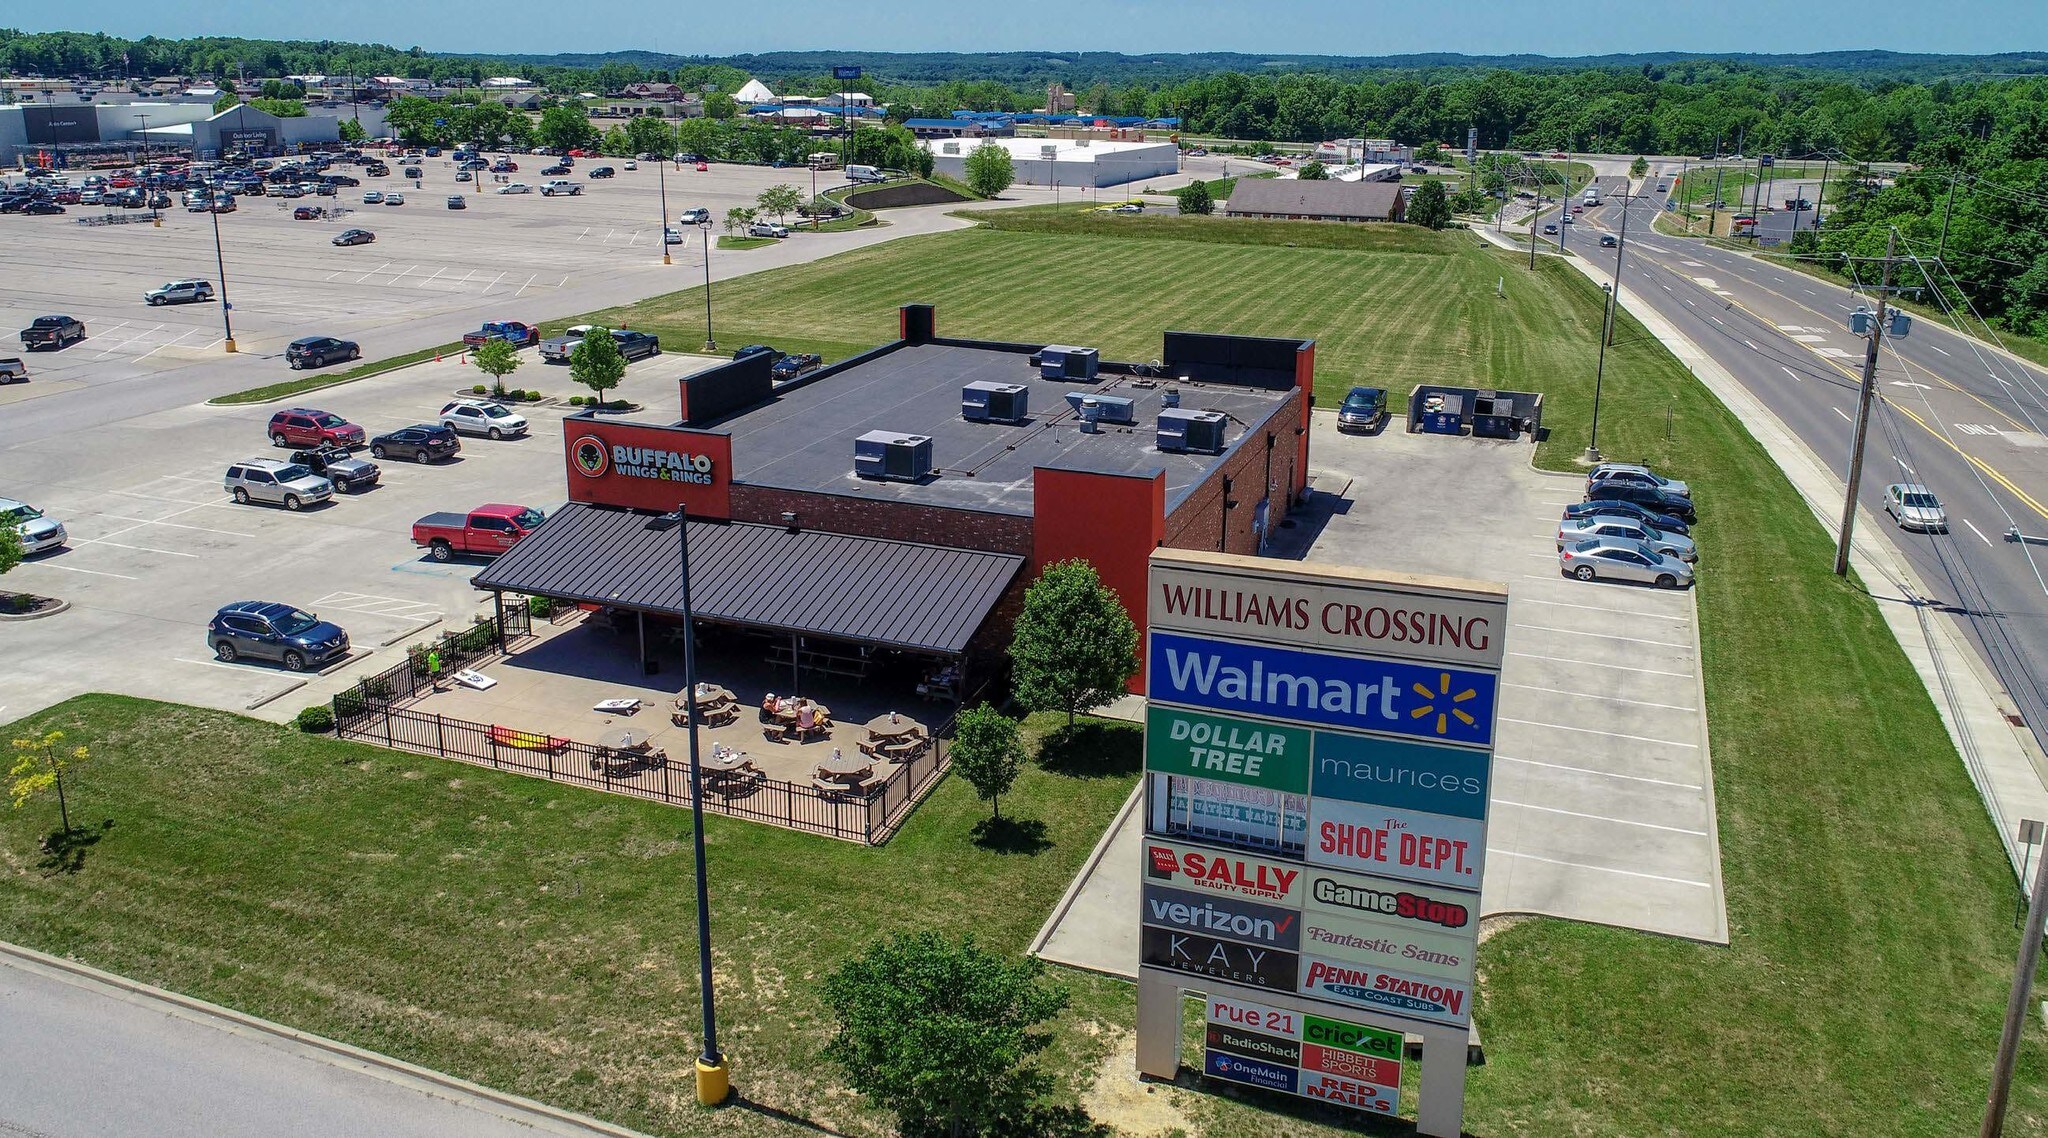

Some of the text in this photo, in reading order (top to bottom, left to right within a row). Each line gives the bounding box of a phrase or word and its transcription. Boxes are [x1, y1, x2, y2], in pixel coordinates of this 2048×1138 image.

[1953, 424, 2005, 436] ONLY
[613, 445, 712, 473] BUFFALO
[615, 463, 713, 486] WINGS & RINGS
[1162, 583, 1490, 651] WILLIAMS CROSSING
[1165, 648, 1402, 720] Walmart
[1170, 719, 1288, 756] DOLLAR
[1189, 747, 1265, 778] TREE
[1321, 757, 1481, 795] maurices
[1384, 818, 1408, 830] The
[1153, 851, 1174, 862] SALLY
[1320, 821, 1473, 875] SHOE DEPT.
[1182, 852, 1299, 894] SALLY
[1194, 878, 1286, 901] BEAUTY SUPPLY
[1314, 878, 1468, 928] GameStop
[1149, 898, 1276, 941] verizon
[1171, 933, 1266, 974] KAY
[1307, 926, 1460, 967] Fantastic Sams
[1170, 961, 1266, 985] JEWELERS
[1305, 961, 1464, 1016] PENN STATION
[1333, 985, 1434, 1011] EAST COAST SUBS
[1214, 1003, 1295, 1034] rue 21
[1222, 1034, 1299, 1060] RadioShack
[1308, 1023, 1397, 1055] cricket
[1233, 1062, 1288, 1082] OneMain
[1321, 1048, 1378, 1068] HIBBETT
[1321, 1059, 1377, 1078] SPORTS
[1250, 1074, 1288, 1090] Financial
[1321, 1076, 1377, 1097] RED
[1307, 1084, 1391, 1112] NAILS
